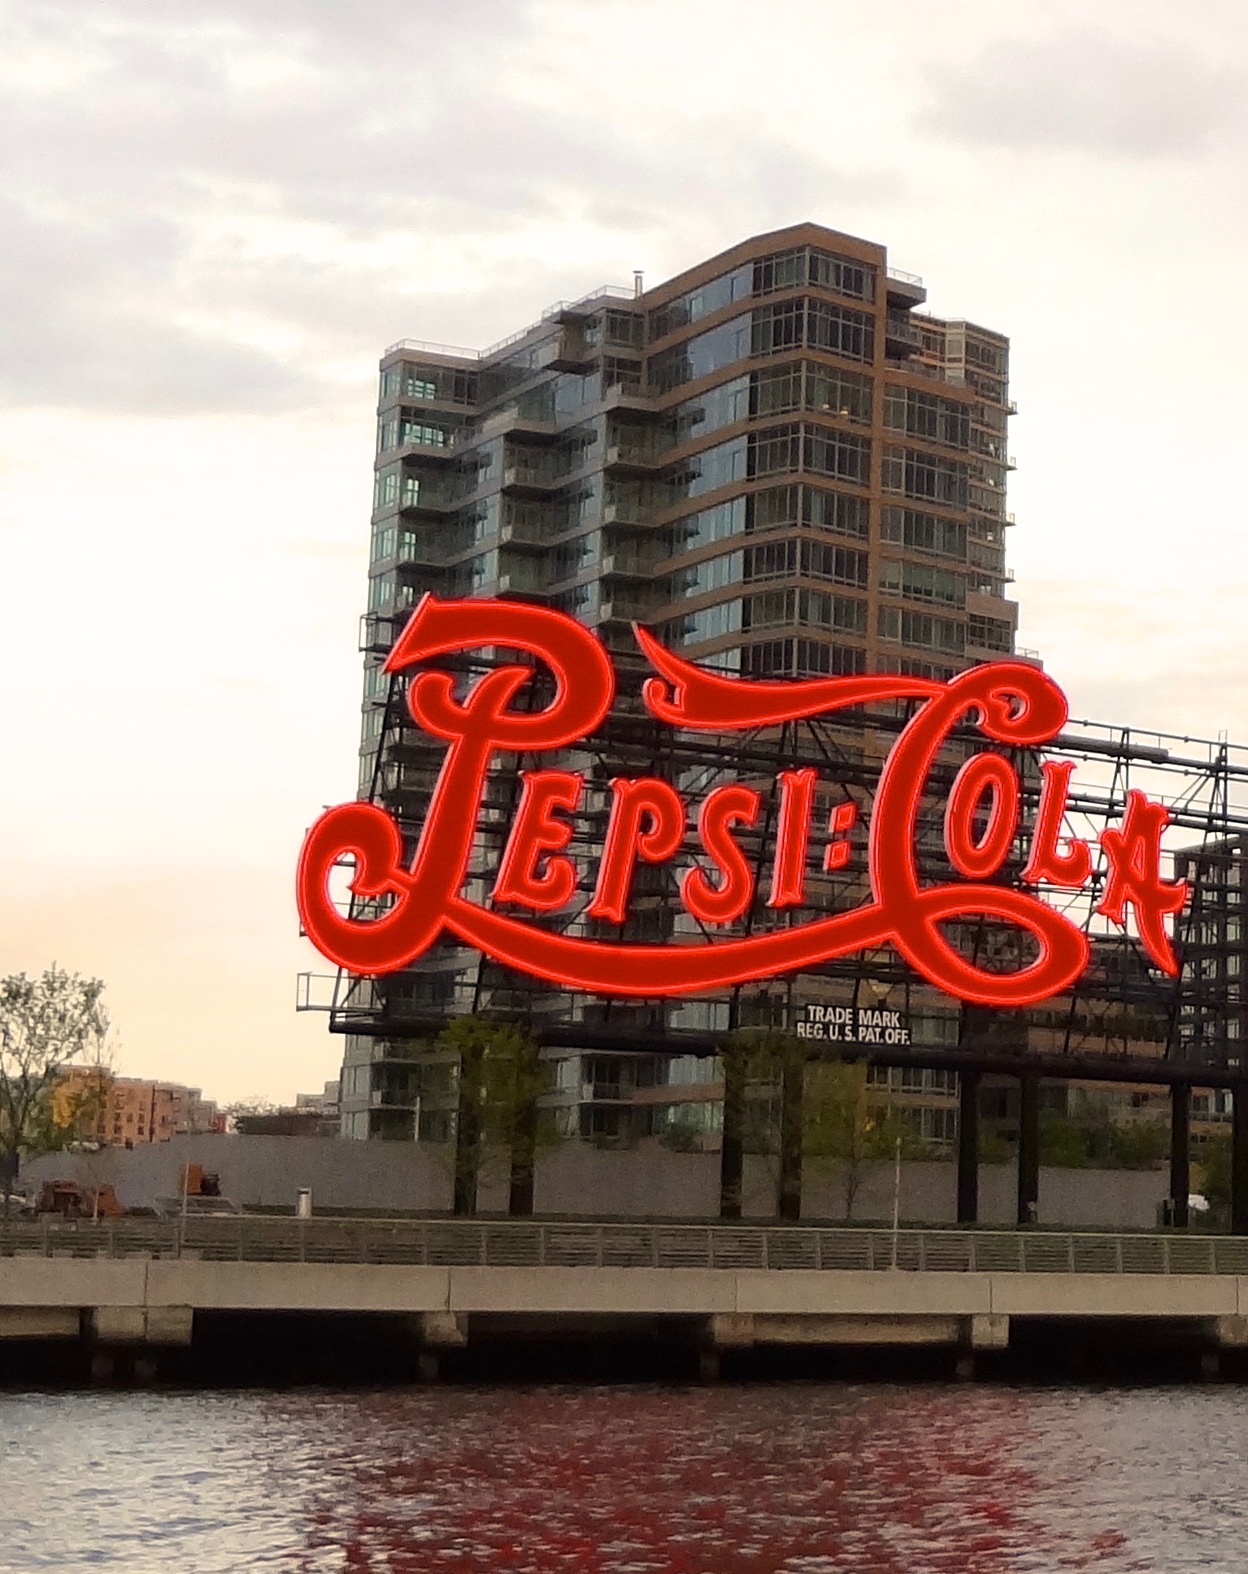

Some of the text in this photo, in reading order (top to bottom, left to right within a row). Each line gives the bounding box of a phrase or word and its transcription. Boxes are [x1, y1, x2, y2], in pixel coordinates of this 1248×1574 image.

[807, 1005, 900, 1027] TRADE MARK
[797, 1022, 827, 1039] REG.
